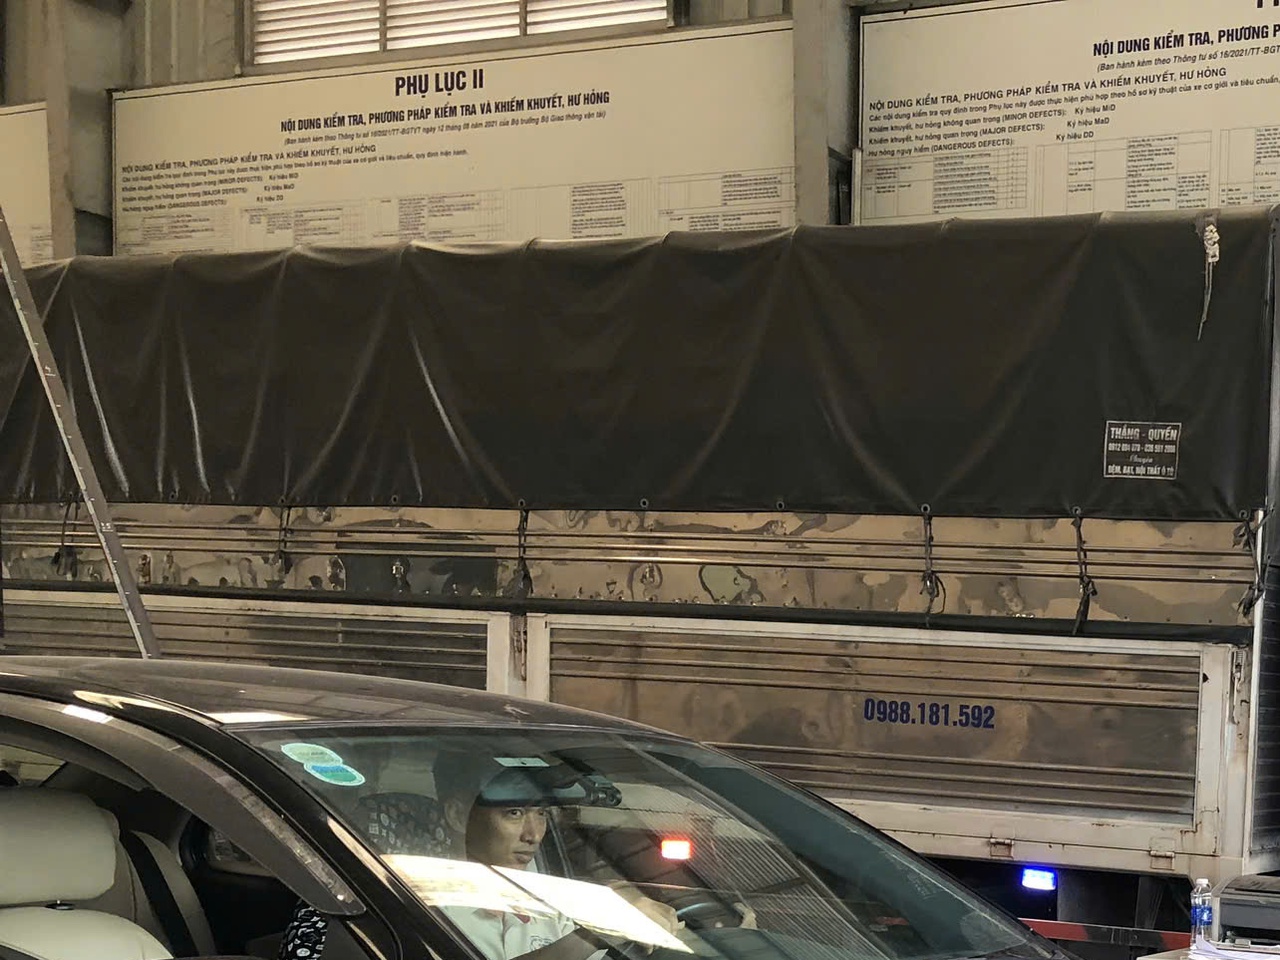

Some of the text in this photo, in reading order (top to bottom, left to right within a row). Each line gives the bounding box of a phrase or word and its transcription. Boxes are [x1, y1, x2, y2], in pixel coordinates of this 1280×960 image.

[1093, 40, 1113, 58] NỘI
[1117, 38, 1149, 53] DUNG
[1153, 30, 1183, 50] KIỂM
[1188, 32, 1213, 46] TRA,
[1218, 25, 1268, 43] PHƯƠNG
[1096, 63, 1114, 72] (Ban
[1136, 59, 1152, 67] kèm
[1172, 55, 1195, 63] Thông
[1208, 51, 1217, 60] số
[395, 69, 483, 98] PHỤ LỤC II
[870, 100, 884, 111] NỘI
[887, 99, 912, 109] DUNG
[916, 93, 937, 106] KIỂM
[940, 95, 960, 103] TRA,
[964, 90, 1003, 101] PHƯƠNG
[1006, 87, 1031, 97] PHÁP
[1036, 81, 1058, 94] KIỂM
[1061, 83, 1080, 91] TRA
[1084, 79, 1096, 89] VÀ
[1100, 75, 1130, 88] KHIẾM
[1179, 71, 1193, 80] HƯ
[1196, 66, 1226, 78] HỎNG
[280, 89, 609, 133] NỘI DUNG KIỂM TRA, PHƯƠNG PHÁP KIỂM TRA VÀ KHIẾM KHUYẾT, HƯ HỎNG
[1002, 113, 1026, 122] (MINOR
[979, 127, 1005, 136] (MAJOR
[931, 142, 975, 153] (DANGEROUS
[864, 698, 995, 729] 0988.181.592
